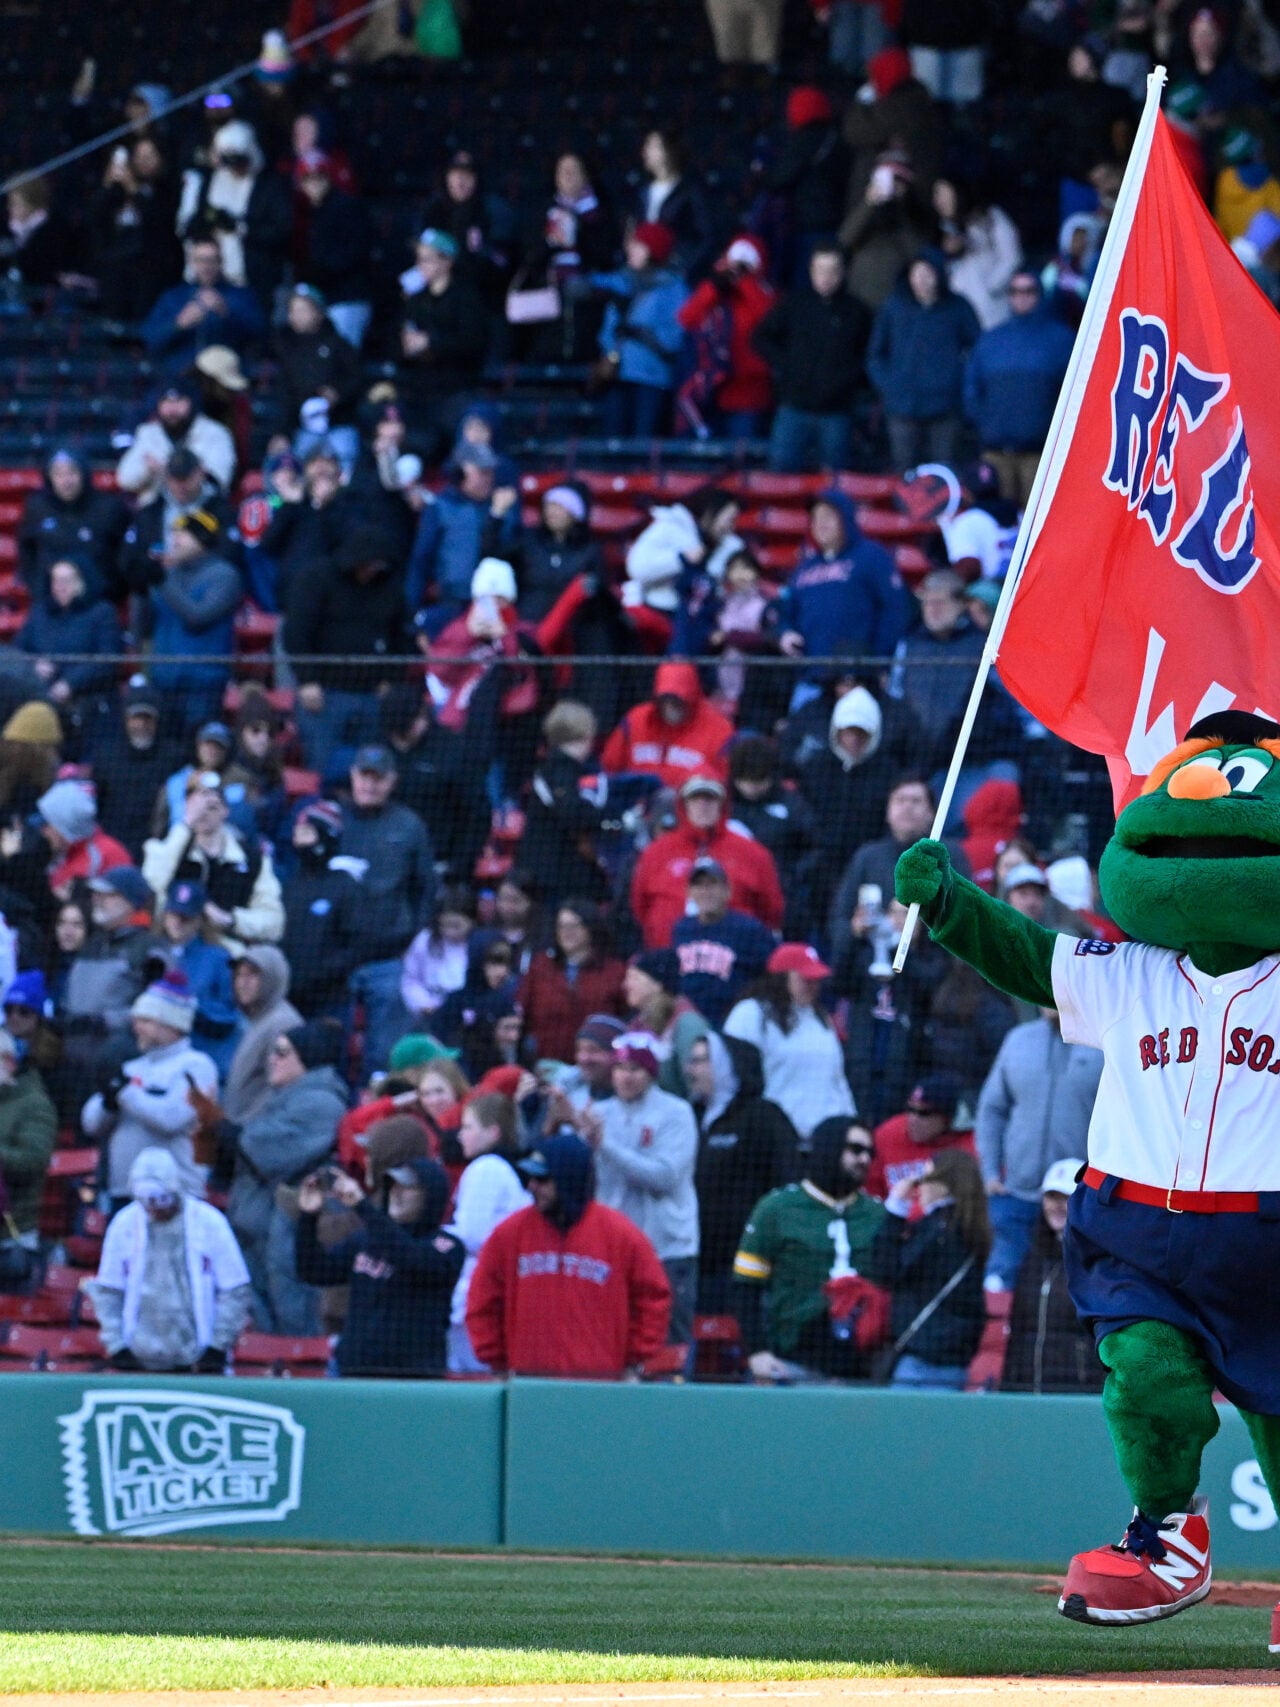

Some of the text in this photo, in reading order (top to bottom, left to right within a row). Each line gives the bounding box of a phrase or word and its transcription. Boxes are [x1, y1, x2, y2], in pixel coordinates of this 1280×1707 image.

[1138, 1026, 1199, 1072] RED
[117, 1411, 274, 1471] ACE
[121, 1474, 270, 1513] TICKET
